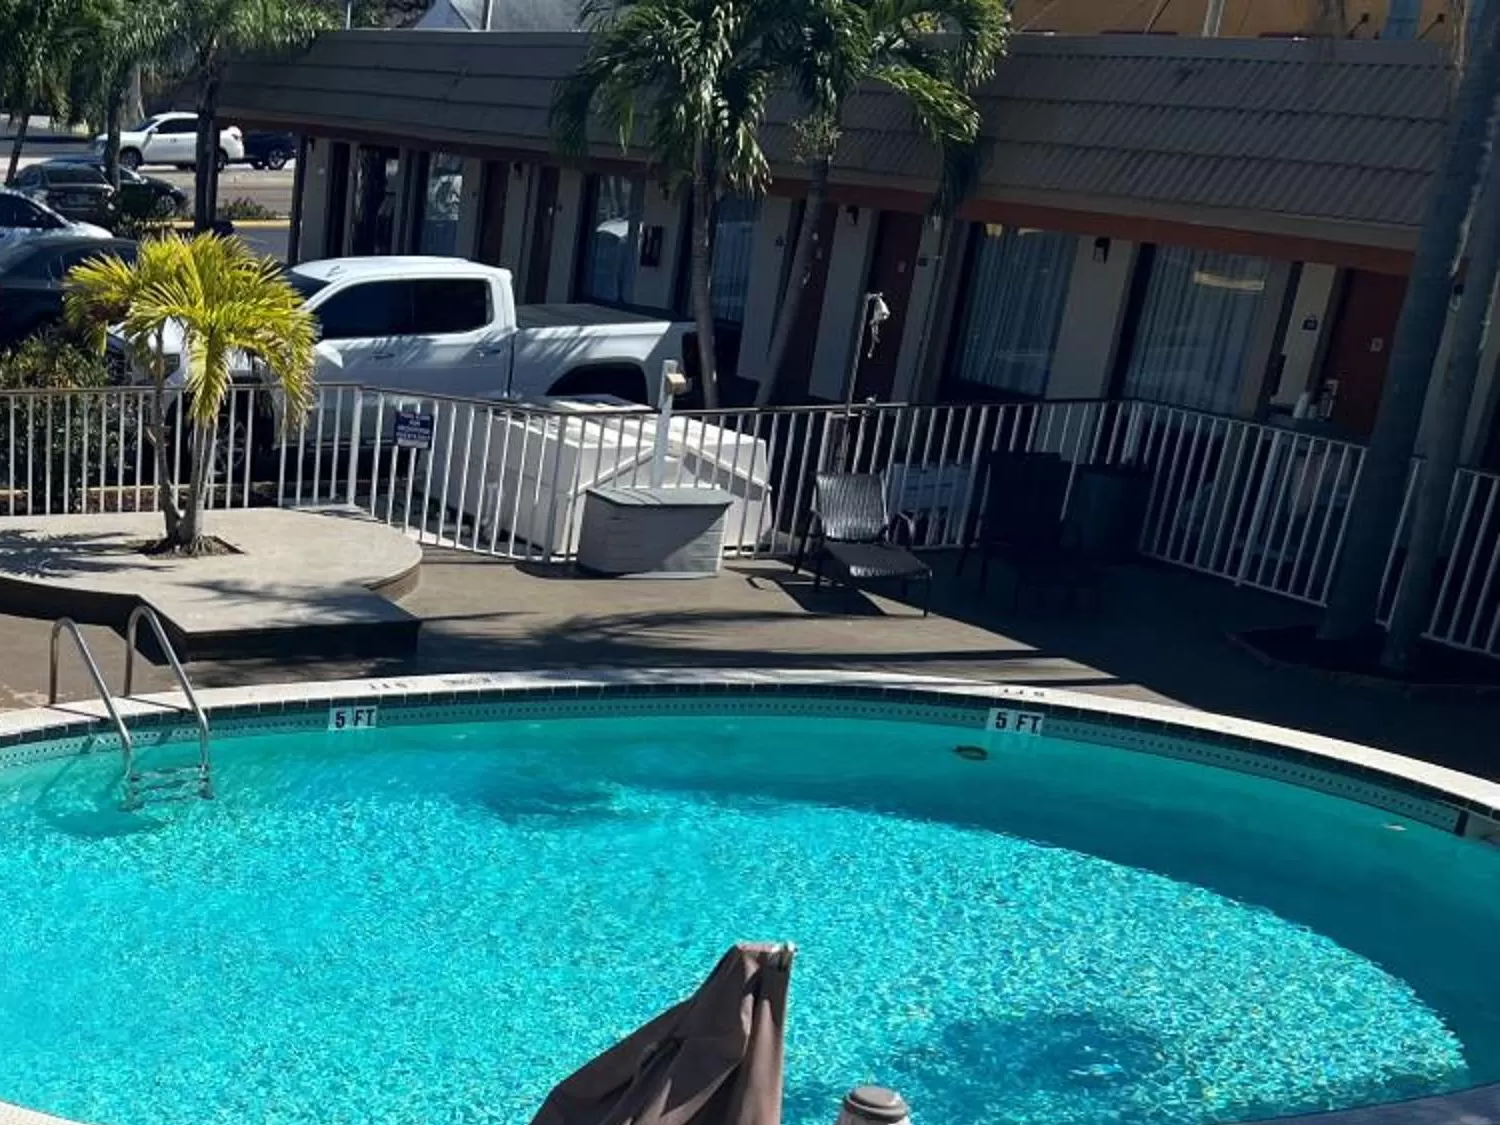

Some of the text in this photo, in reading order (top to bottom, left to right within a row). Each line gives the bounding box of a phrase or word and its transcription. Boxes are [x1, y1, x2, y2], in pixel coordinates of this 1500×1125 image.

[335, 709, 375, 728] 5 FT
[995, 711, 1042, 735] 5 FT
